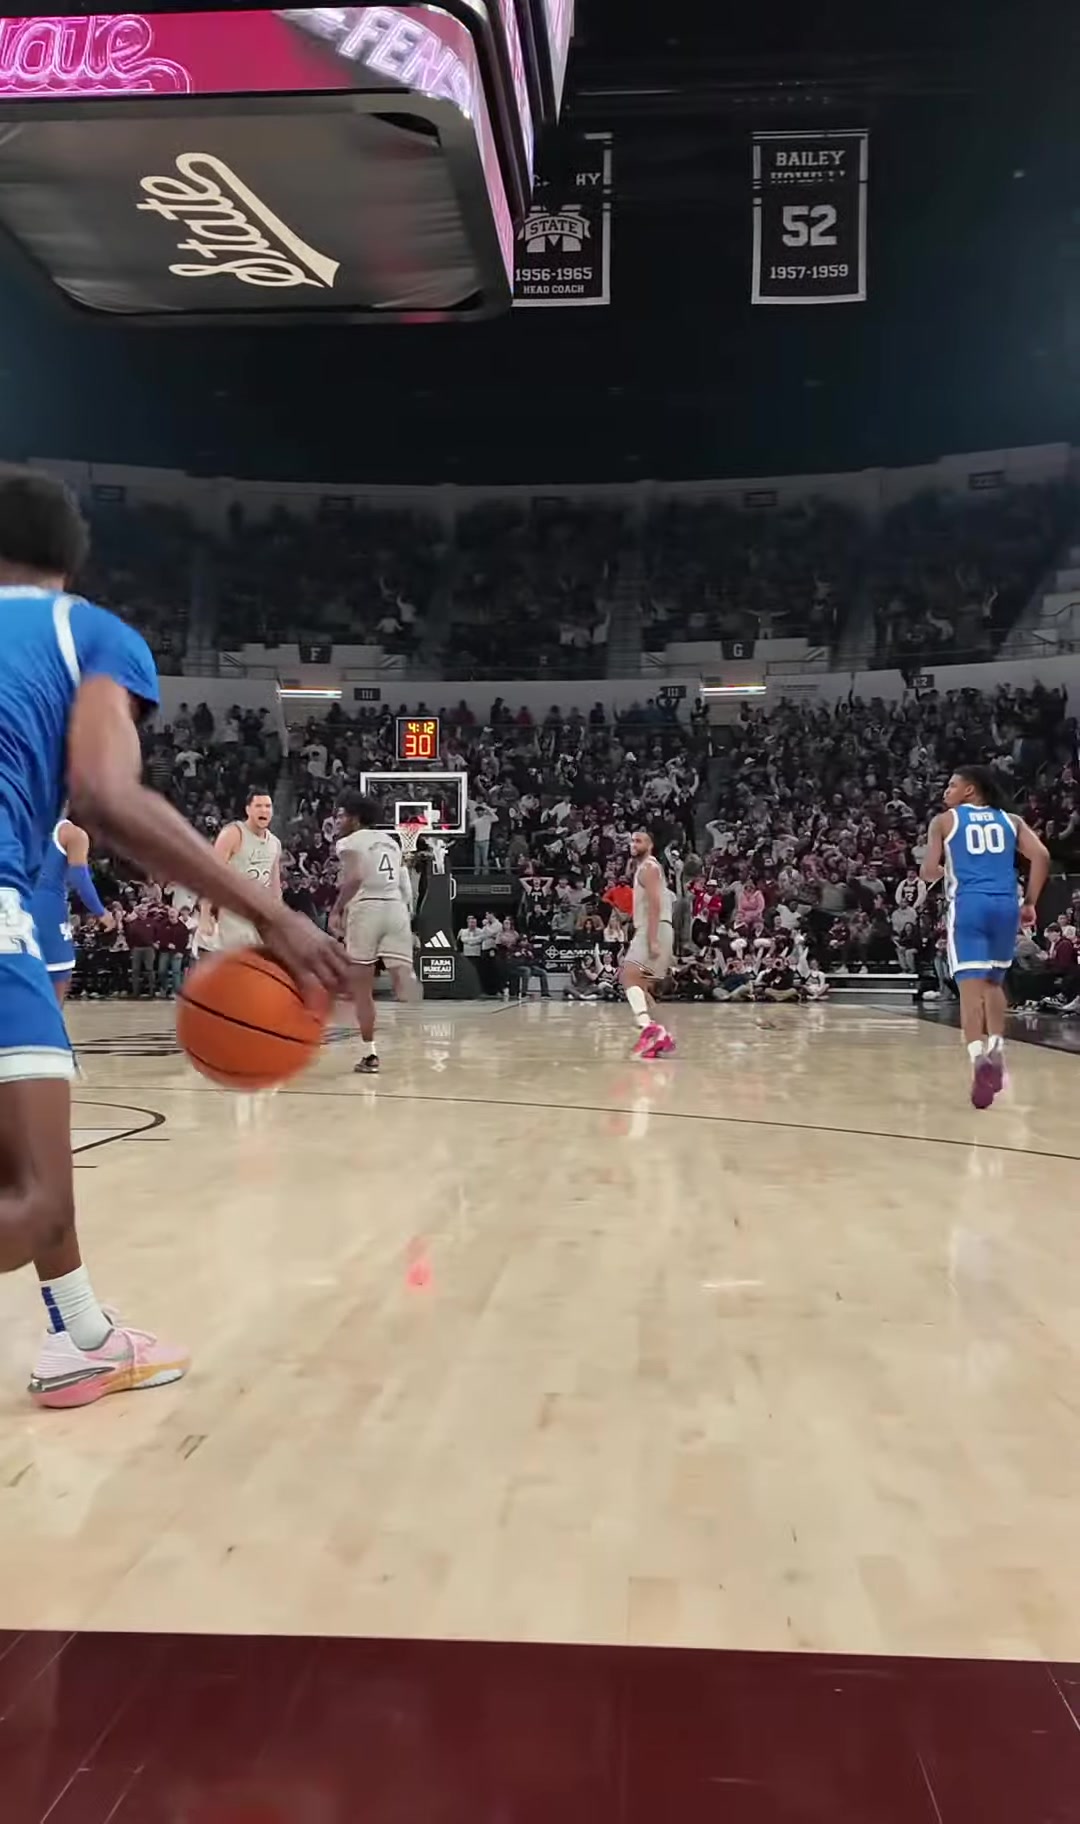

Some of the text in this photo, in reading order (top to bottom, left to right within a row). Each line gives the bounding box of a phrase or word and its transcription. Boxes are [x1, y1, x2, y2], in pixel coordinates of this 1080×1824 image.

[776, 150, 846, 166] BAILEY
[136, 152, 340, 288] State
[530, 219, 579, 235] STATE
[782, 204, 838, 247] 52
[515, 267, 593, 281] 1956-1965
[770, 264, 849, 279] 1957-1959
[523, 284, 585, 294] HEAD COACH
[733, 643, 743, 657] G
[407, 722, 435, 734] 4:12
[405, 734, 431, 756] 30
[965, 823, 1005, 855] 00
[378, 853, 395, 881] 4
